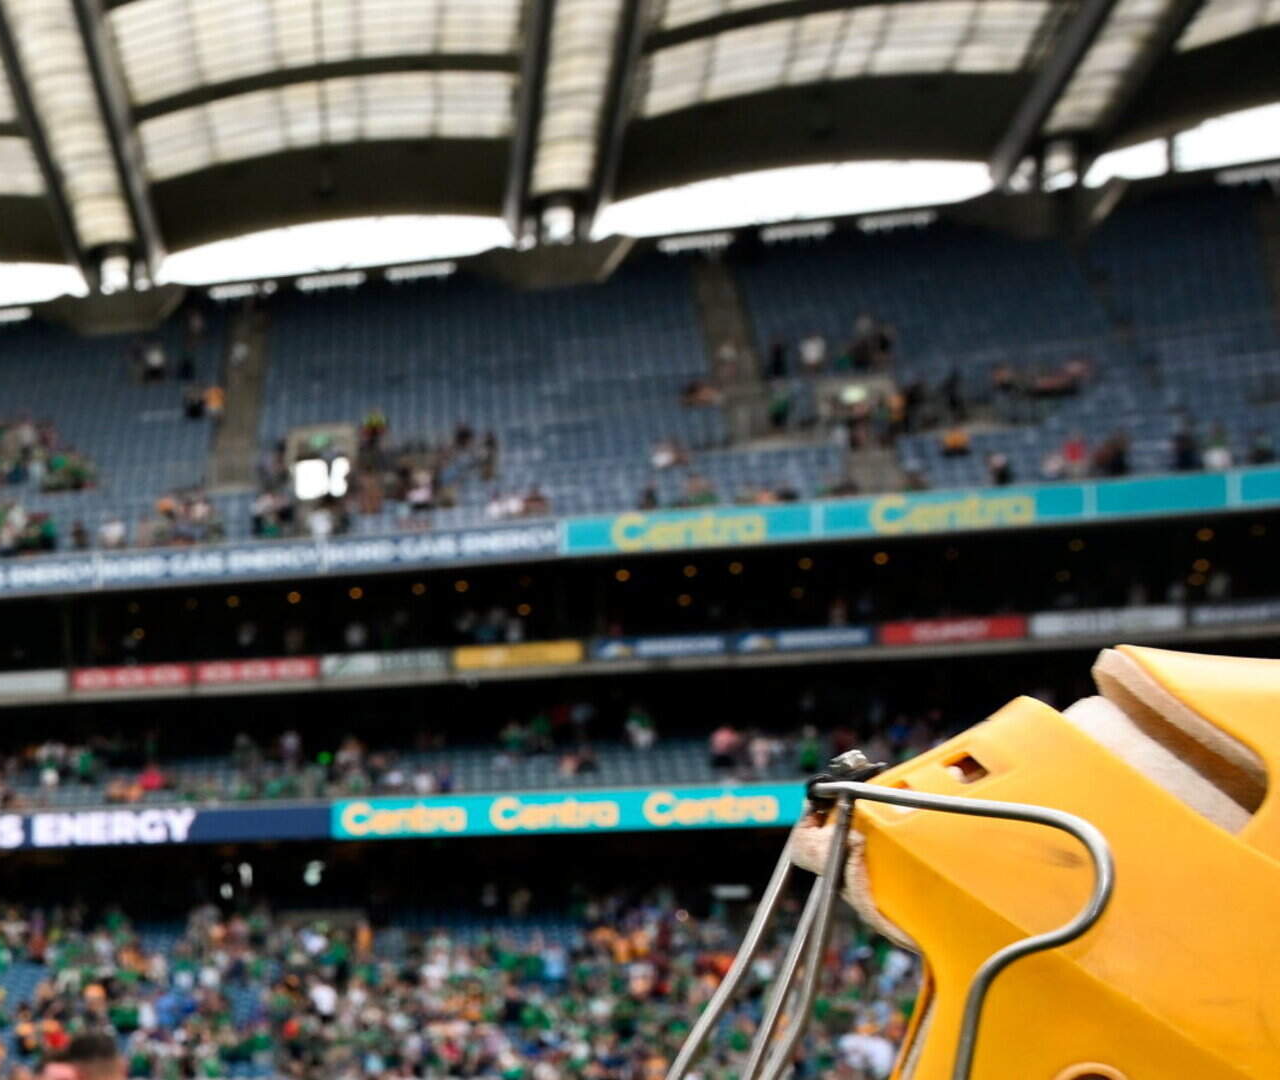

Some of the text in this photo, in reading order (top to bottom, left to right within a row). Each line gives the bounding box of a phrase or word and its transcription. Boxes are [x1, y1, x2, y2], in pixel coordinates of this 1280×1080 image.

[610, 510, 765, 551] Centra
[869, 494, 1035, 535] Centra
[32, 807, 196, 848] ENERGY
[342, 802, 467, 836] Centra
[489, 796, 618, 832] Centra
[644, 792, 778, 826] Centra
